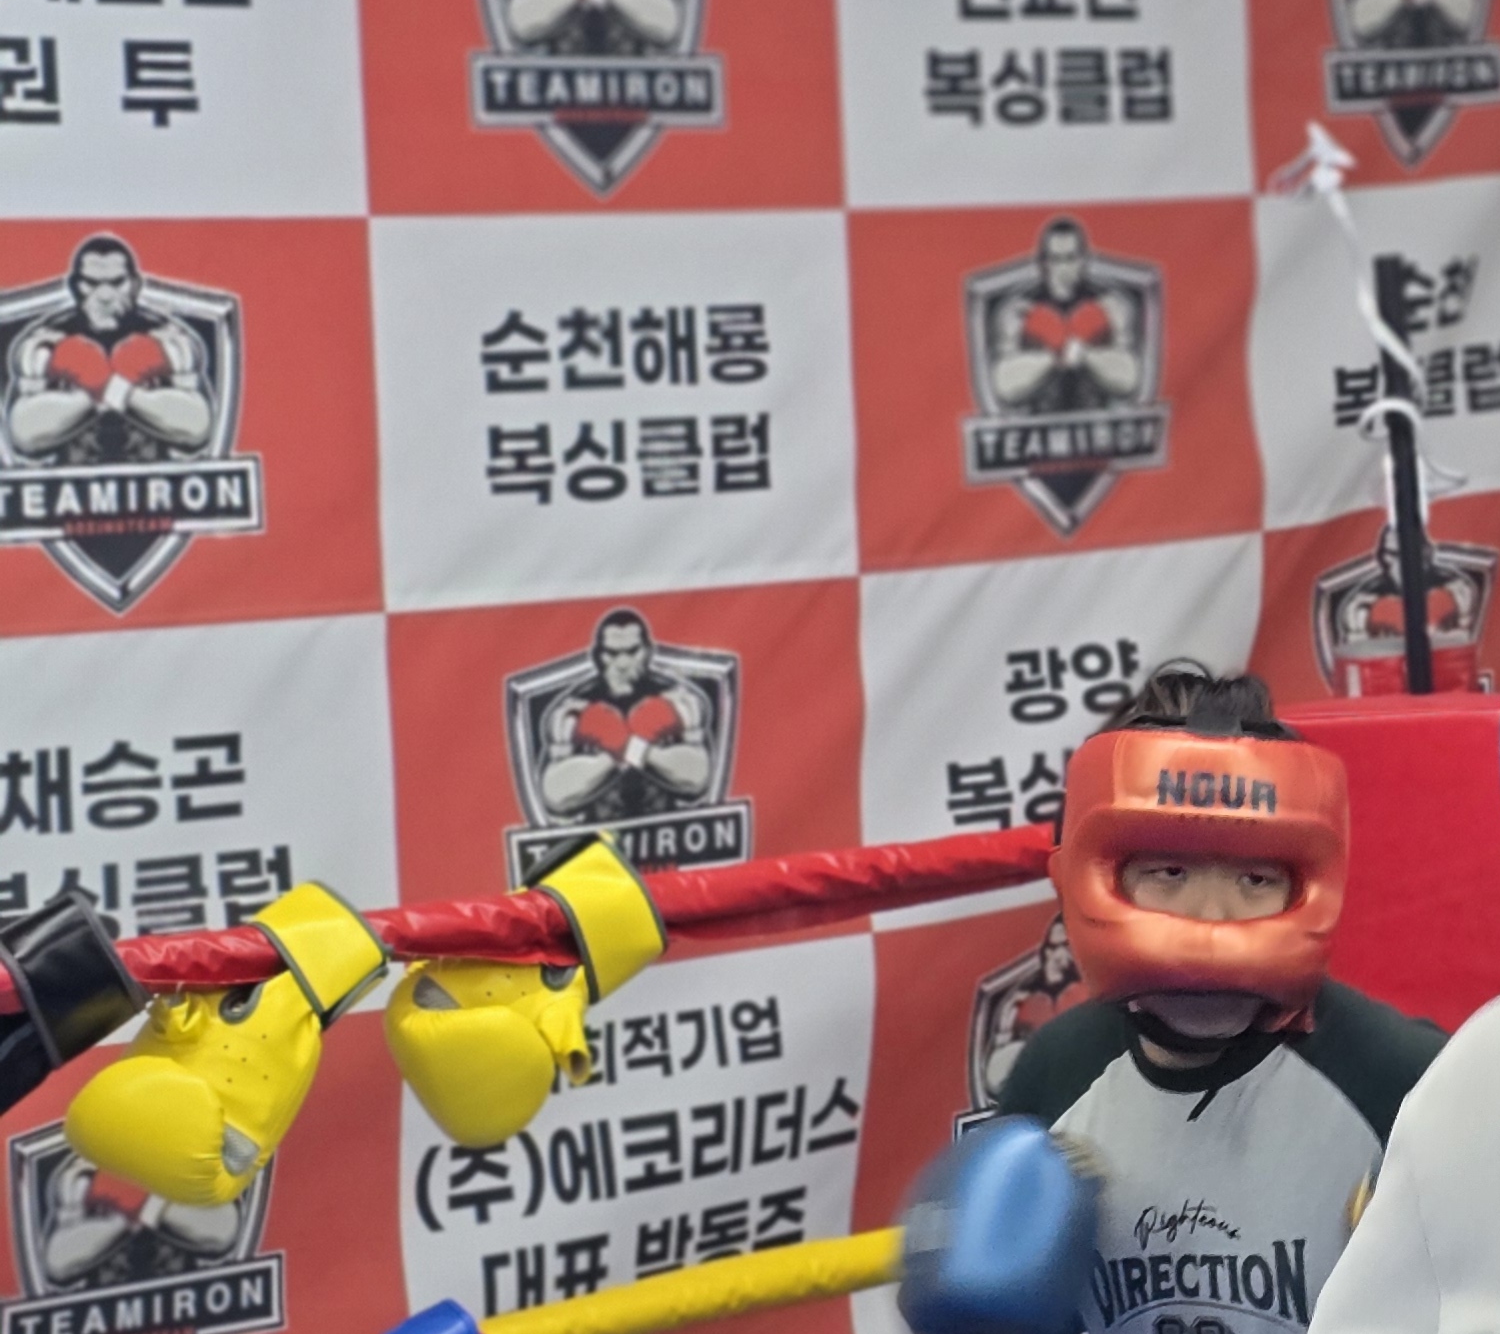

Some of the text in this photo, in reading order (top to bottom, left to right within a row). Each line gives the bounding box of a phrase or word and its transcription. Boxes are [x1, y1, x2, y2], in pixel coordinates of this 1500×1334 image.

[122, 41, 200, 127] 투
[488, 71, 706, 107] TEAMIRON
[924, 46, 1173, 126] 복싱클럽
[481, 303, 770, 394] 순천해룡
[485, 412, 771, 505] 복싱클럽
[1005, 638, 1140, 724] 광양
[0, 732, 245, 835] 채승곤
[415, 1077, 861, 1232] (주)에코리더스
[1092, 1237, 1310, 1329] DIRECTION
